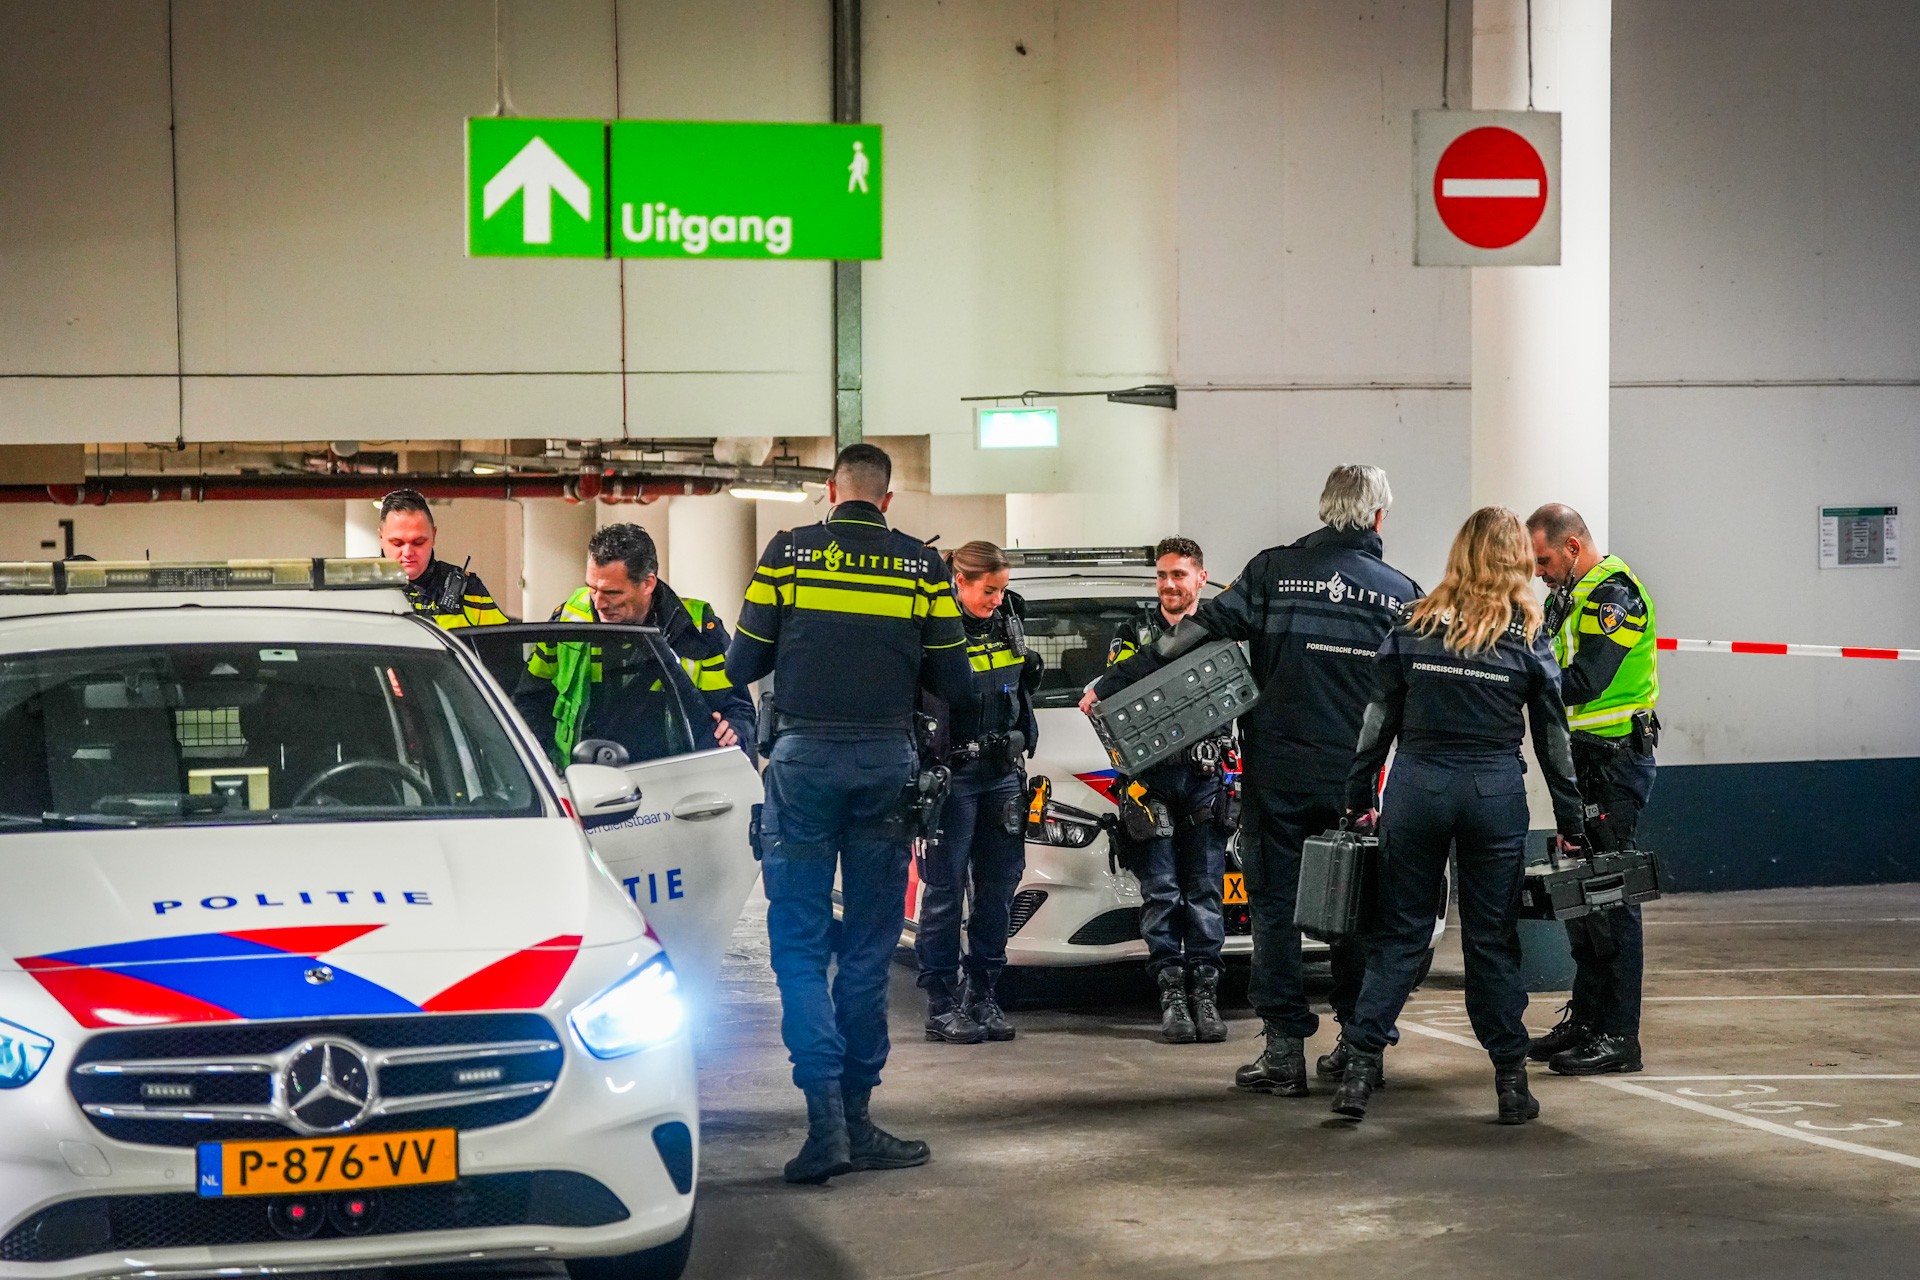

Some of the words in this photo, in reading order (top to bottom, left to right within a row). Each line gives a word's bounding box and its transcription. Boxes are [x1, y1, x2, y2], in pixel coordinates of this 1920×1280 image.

[622, 202, 792, 255] Uitgang
[1306, 642, 1352, 655] FORENSISCHE
[1353, 648, 1377, 658] OPSPO
[1412, 662, 1464, 676] FORENSISCHE
[1464, 669, 1510, 683] OPSPORING
[603, 812, 661, 832] dienstbaar
[152, 891, 433, 915] POLITIE
[239, 1138, 435, 1187] P-876-VV
[202, 1174, 219, 1187] NL
